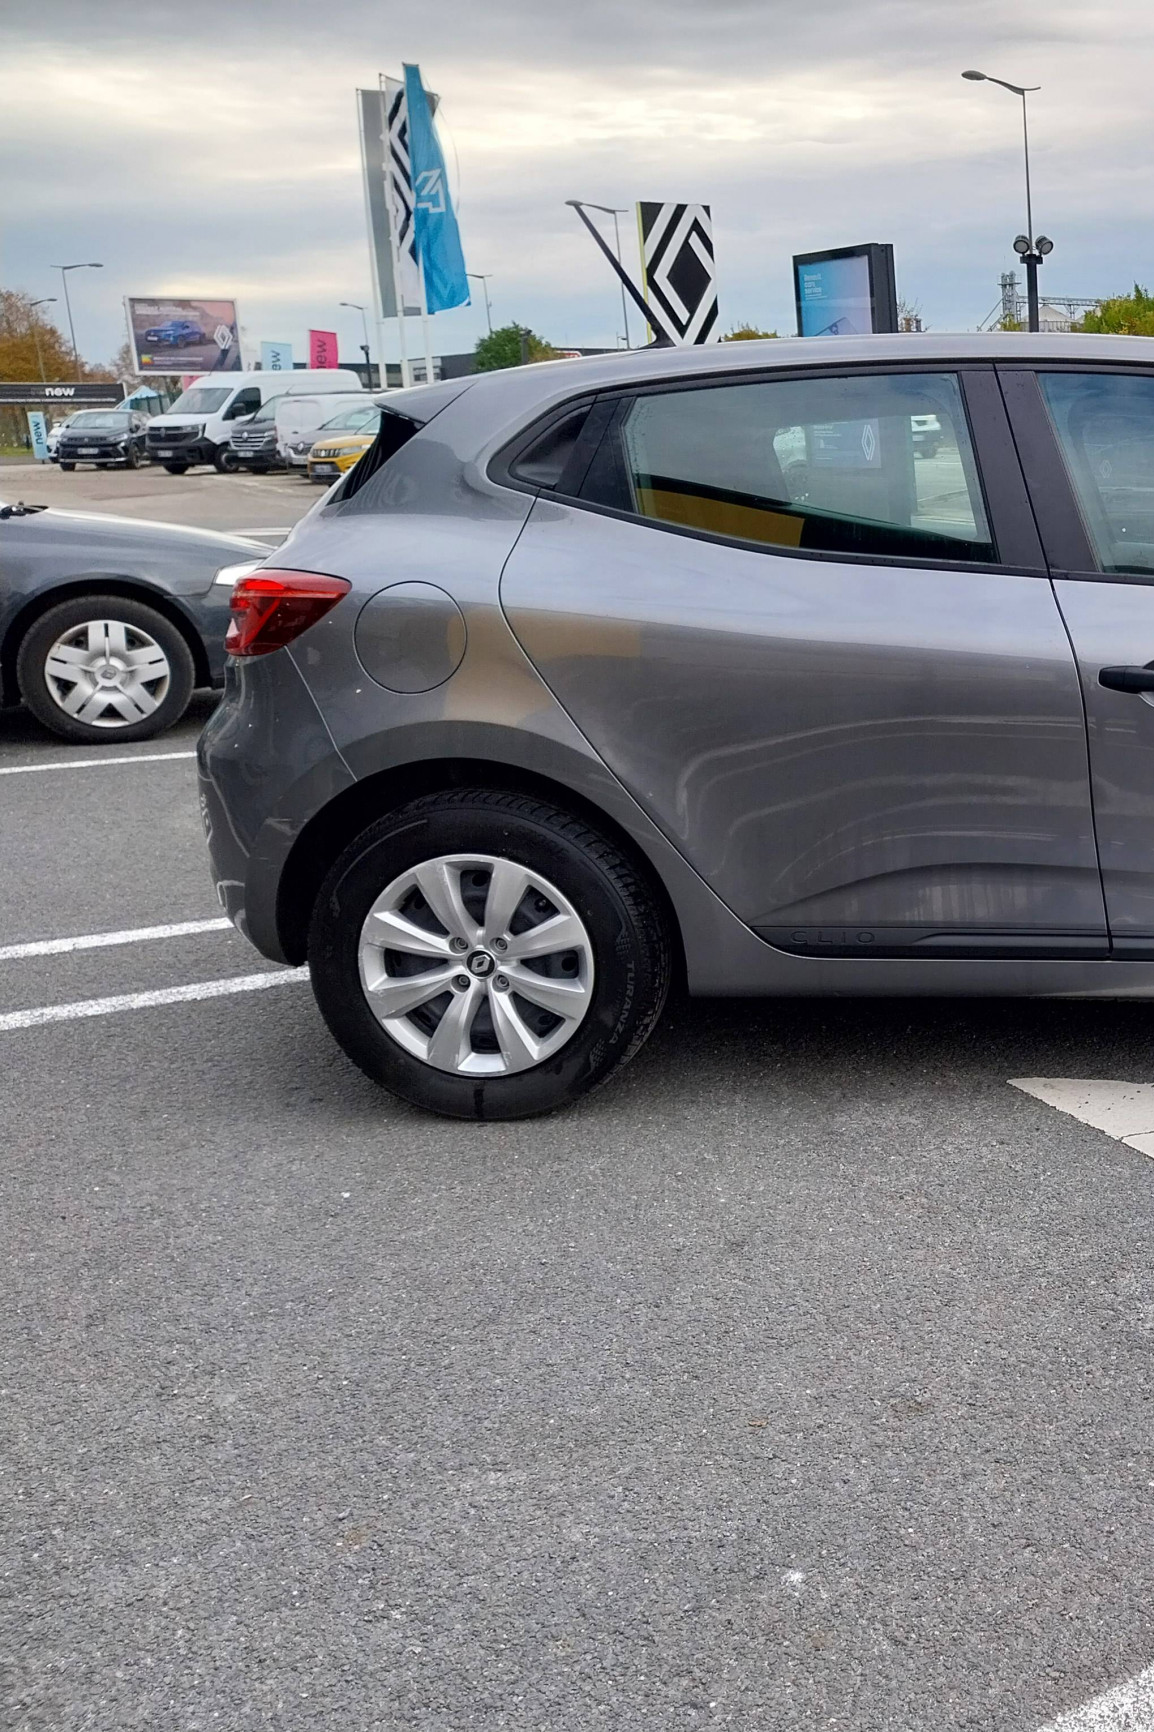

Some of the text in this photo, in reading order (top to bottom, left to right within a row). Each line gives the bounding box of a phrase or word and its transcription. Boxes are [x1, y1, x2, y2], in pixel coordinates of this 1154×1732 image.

[271, 350, 282, 370] ew
[45, 387, 75, 396] new
[32, 420, 44, 445] new
[790, 930, 875, 945] CLIO
[608, 960, 635, 1044] TURANZA
